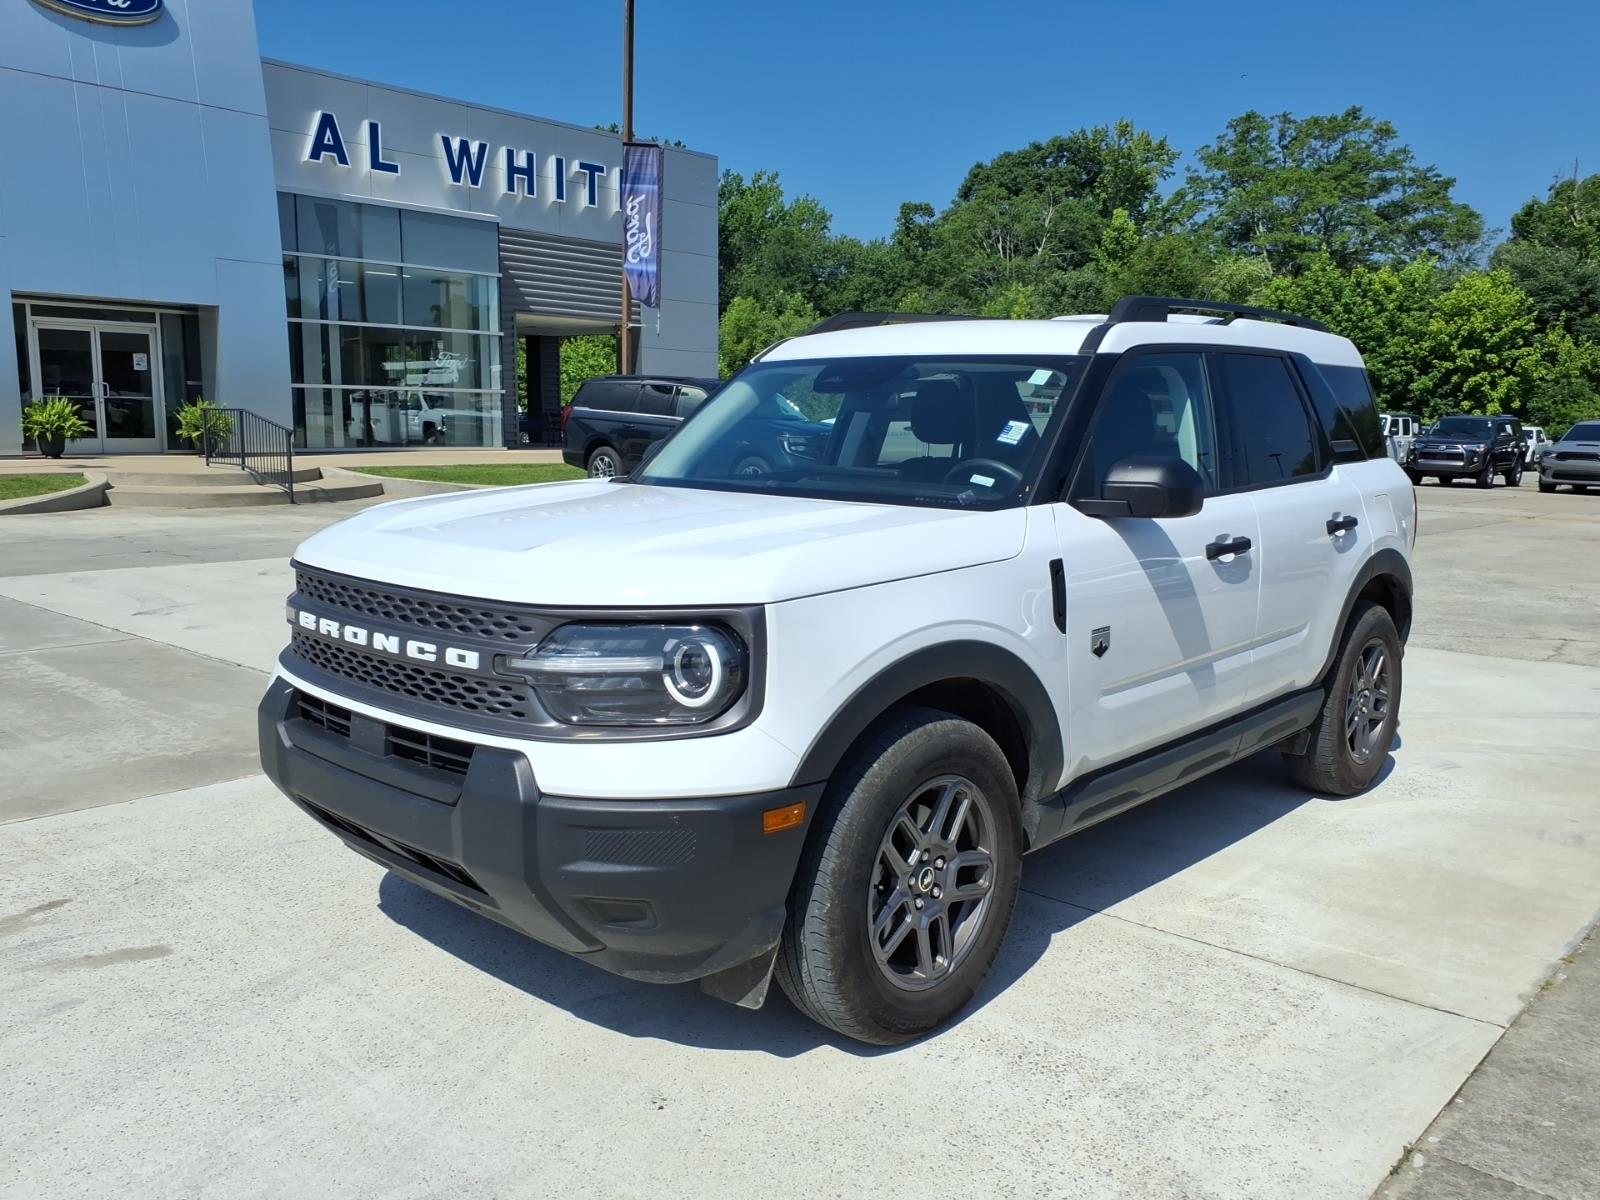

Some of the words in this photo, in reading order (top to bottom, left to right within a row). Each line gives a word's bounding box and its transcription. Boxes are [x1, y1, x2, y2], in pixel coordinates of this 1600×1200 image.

[304, 110, 400, 176] AL
[438, 132, 622, 211] WHIT
[299, 611, 480, 670] BRONCO
